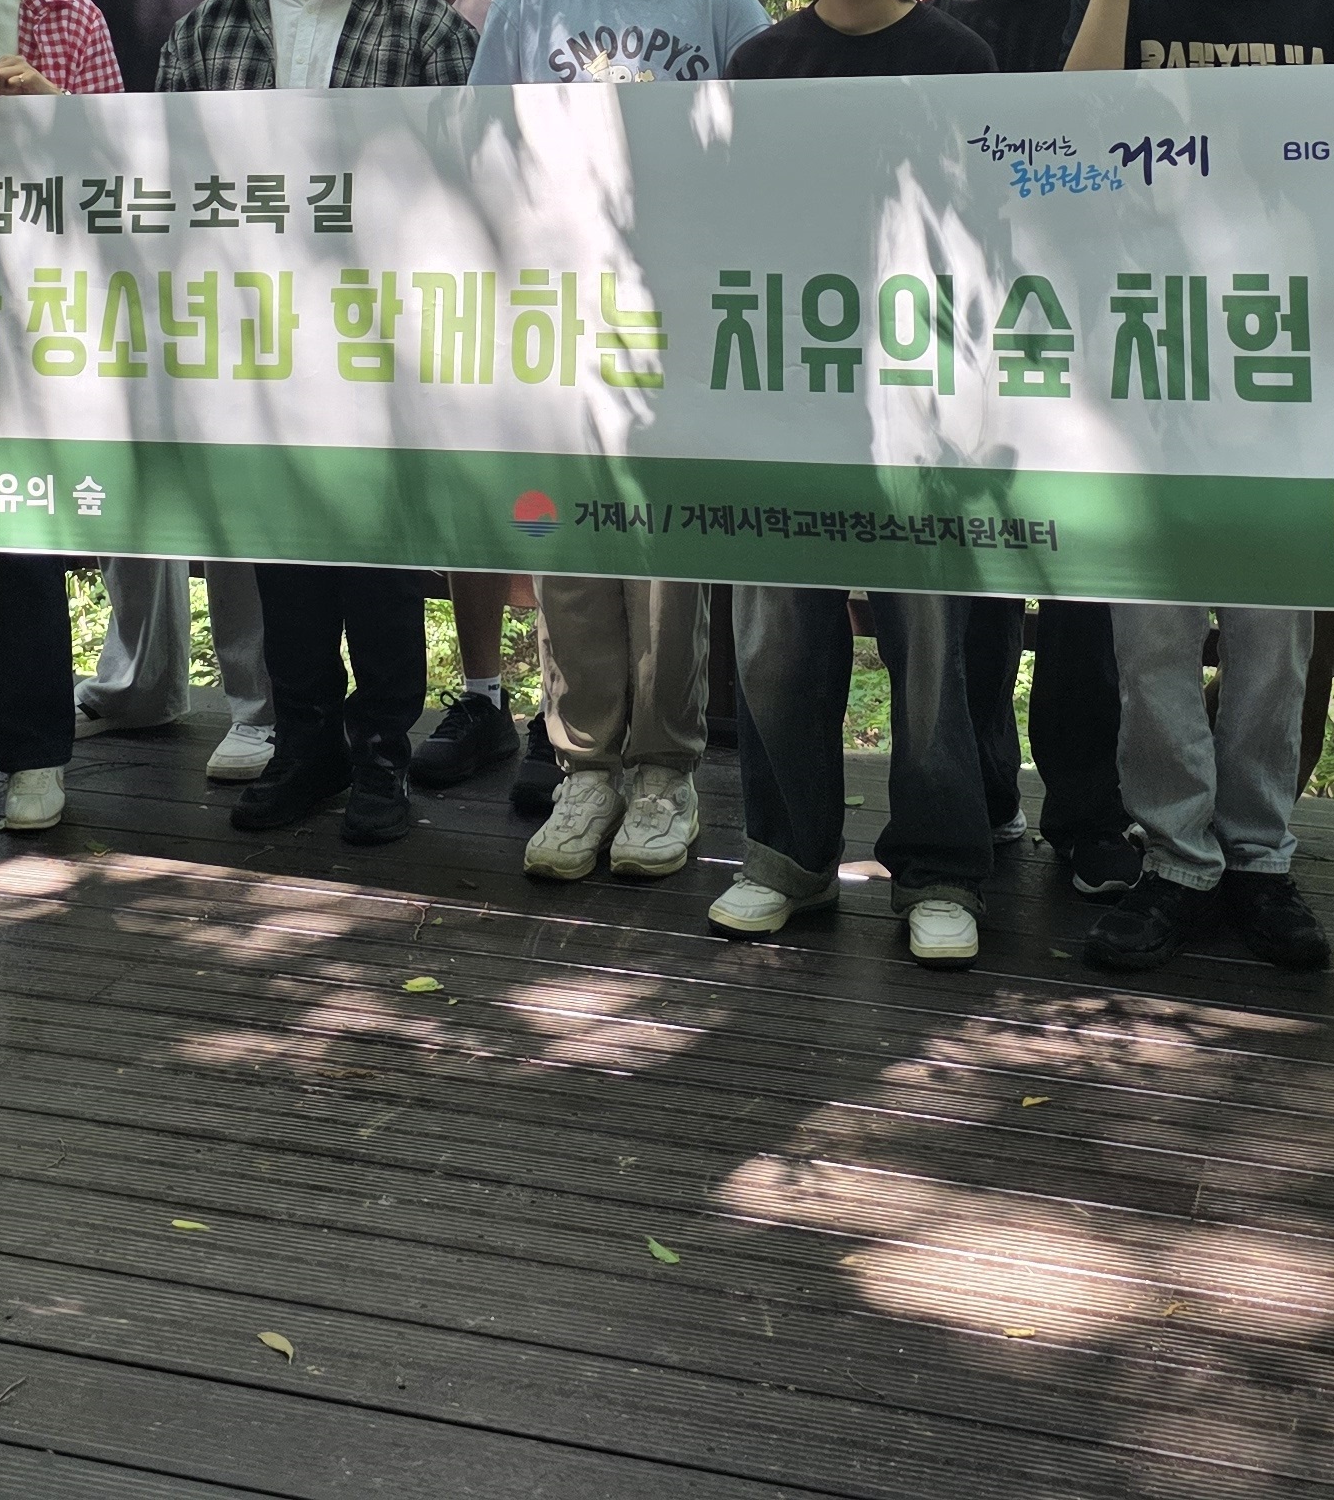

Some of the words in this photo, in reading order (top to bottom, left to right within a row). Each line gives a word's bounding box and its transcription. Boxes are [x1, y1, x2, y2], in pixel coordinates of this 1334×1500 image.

[967, 125, 1077, 165] 함께여는
[1108, 135, 1209, 186] 거제
[1283, 140, 1330, 161] BIG
[78, 175, 177, 235] 걷는
[189, 174, 290, 234] 초록
[306, 172, 354, 234] 길
[26, 267, 299, 380] 청소년과
[330, 268, 668, 389] 함께하는
[710, 269, 956, 397] 치유의
[992, 273, 1075, 399] 숲
[1109, 272, 1313, 403] 체험
[72, 475, 107, 516] 숲
[574, 499, 654, 534] 거제시
[680, 503, 1058, 552] 거제시학교밖청소년지원센터
